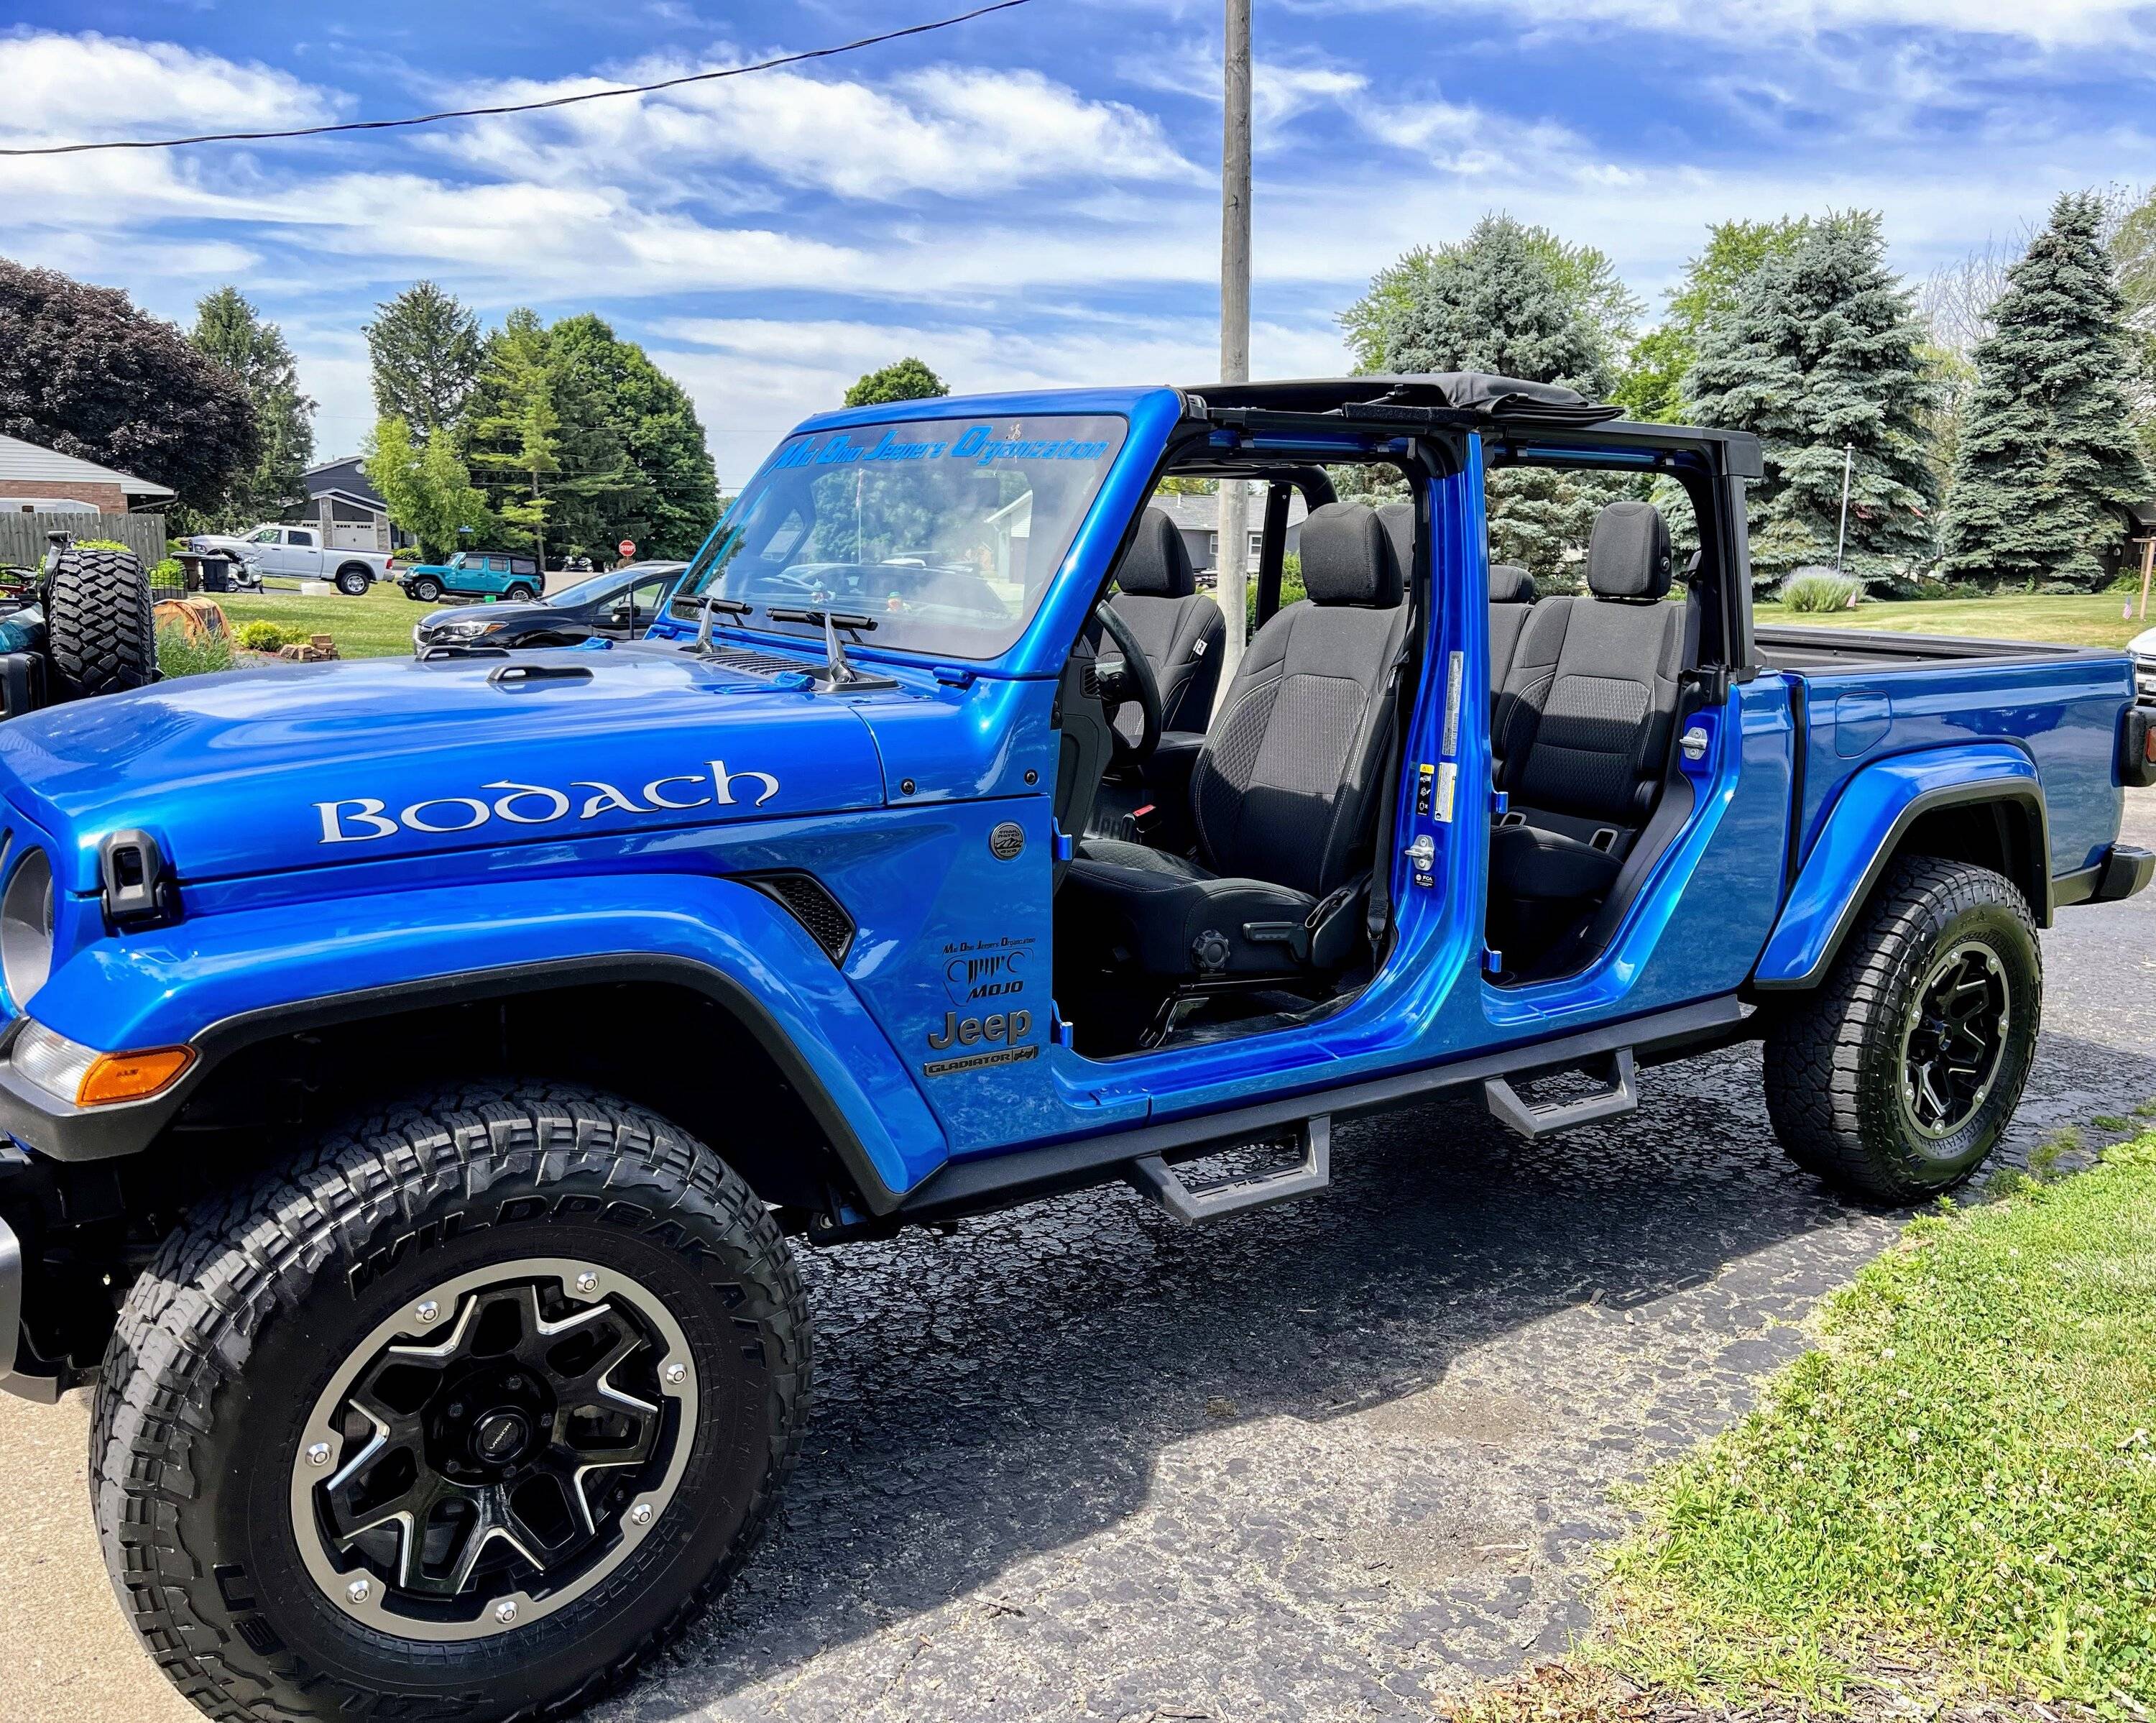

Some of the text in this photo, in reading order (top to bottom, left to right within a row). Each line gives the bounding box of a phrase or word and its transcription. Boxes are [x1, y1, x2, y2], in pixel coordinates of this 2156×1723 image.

[816, 436, 863, 464] Ohio
[863, 431, 948, 461] Jeepers
[950, 426, 1109, 465] Organization
[967, 980, 1024, 1003] MOJO
[929, 1009, 1033, 1050] Jeep
[928, 1050, 1011, 1074] GLADIATOR
[346, 1194, 727, 1301] WILDPEAK
[489, 1422, 512, 1449] VISION
